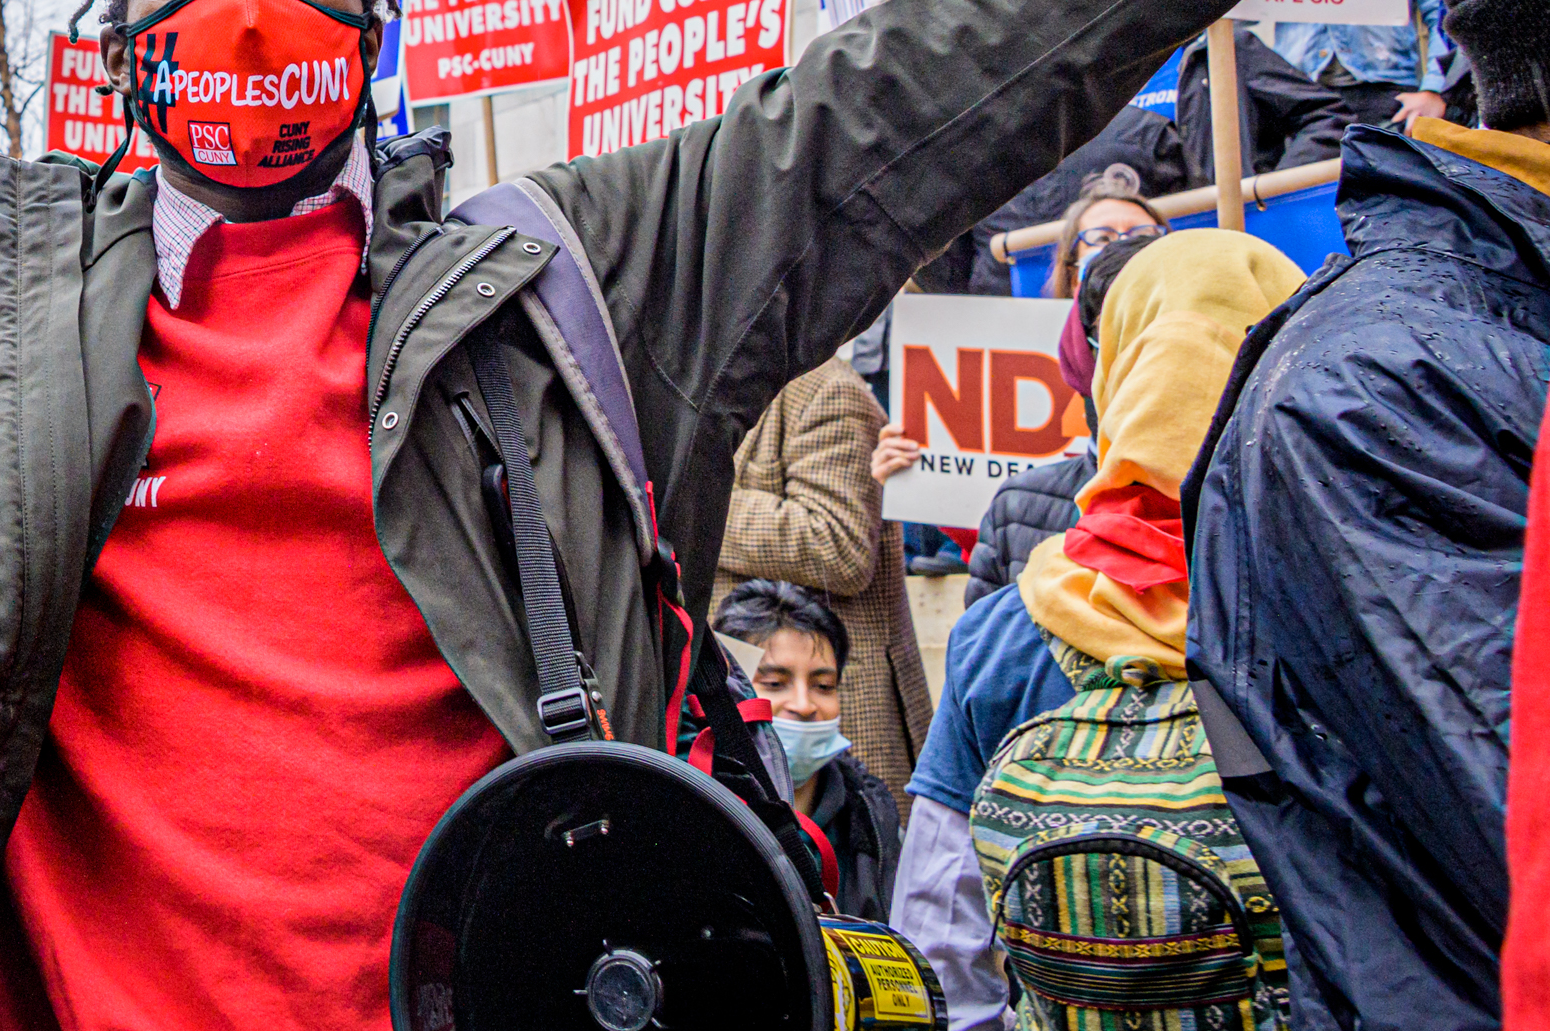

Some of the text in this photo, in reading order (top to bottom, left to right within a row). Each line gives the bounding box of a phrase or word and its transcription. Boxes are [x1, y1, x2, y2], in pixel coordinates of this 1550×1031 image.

[574, 45, 621, 108] THE
[53, 82, 103, 118] THE
[64, 119, 159, 158] UNIVE
[191, 122, 230, 150] PSC
[279, 121, 310, 137] CUNY
[272, 136, 311, 153] RISING
[198, 149, 231, 163] CUNY
[257, 149, 315, 168] ALLIANCE
[920, 454, 975, 476] NEW
[849, 936, 906, 958] CAUTION
[871, 964, 914, 980] AUTHORIZED
[876, 977, 918, 994] PERSONNEL
[892, 994, 910, 1007] ONLY
